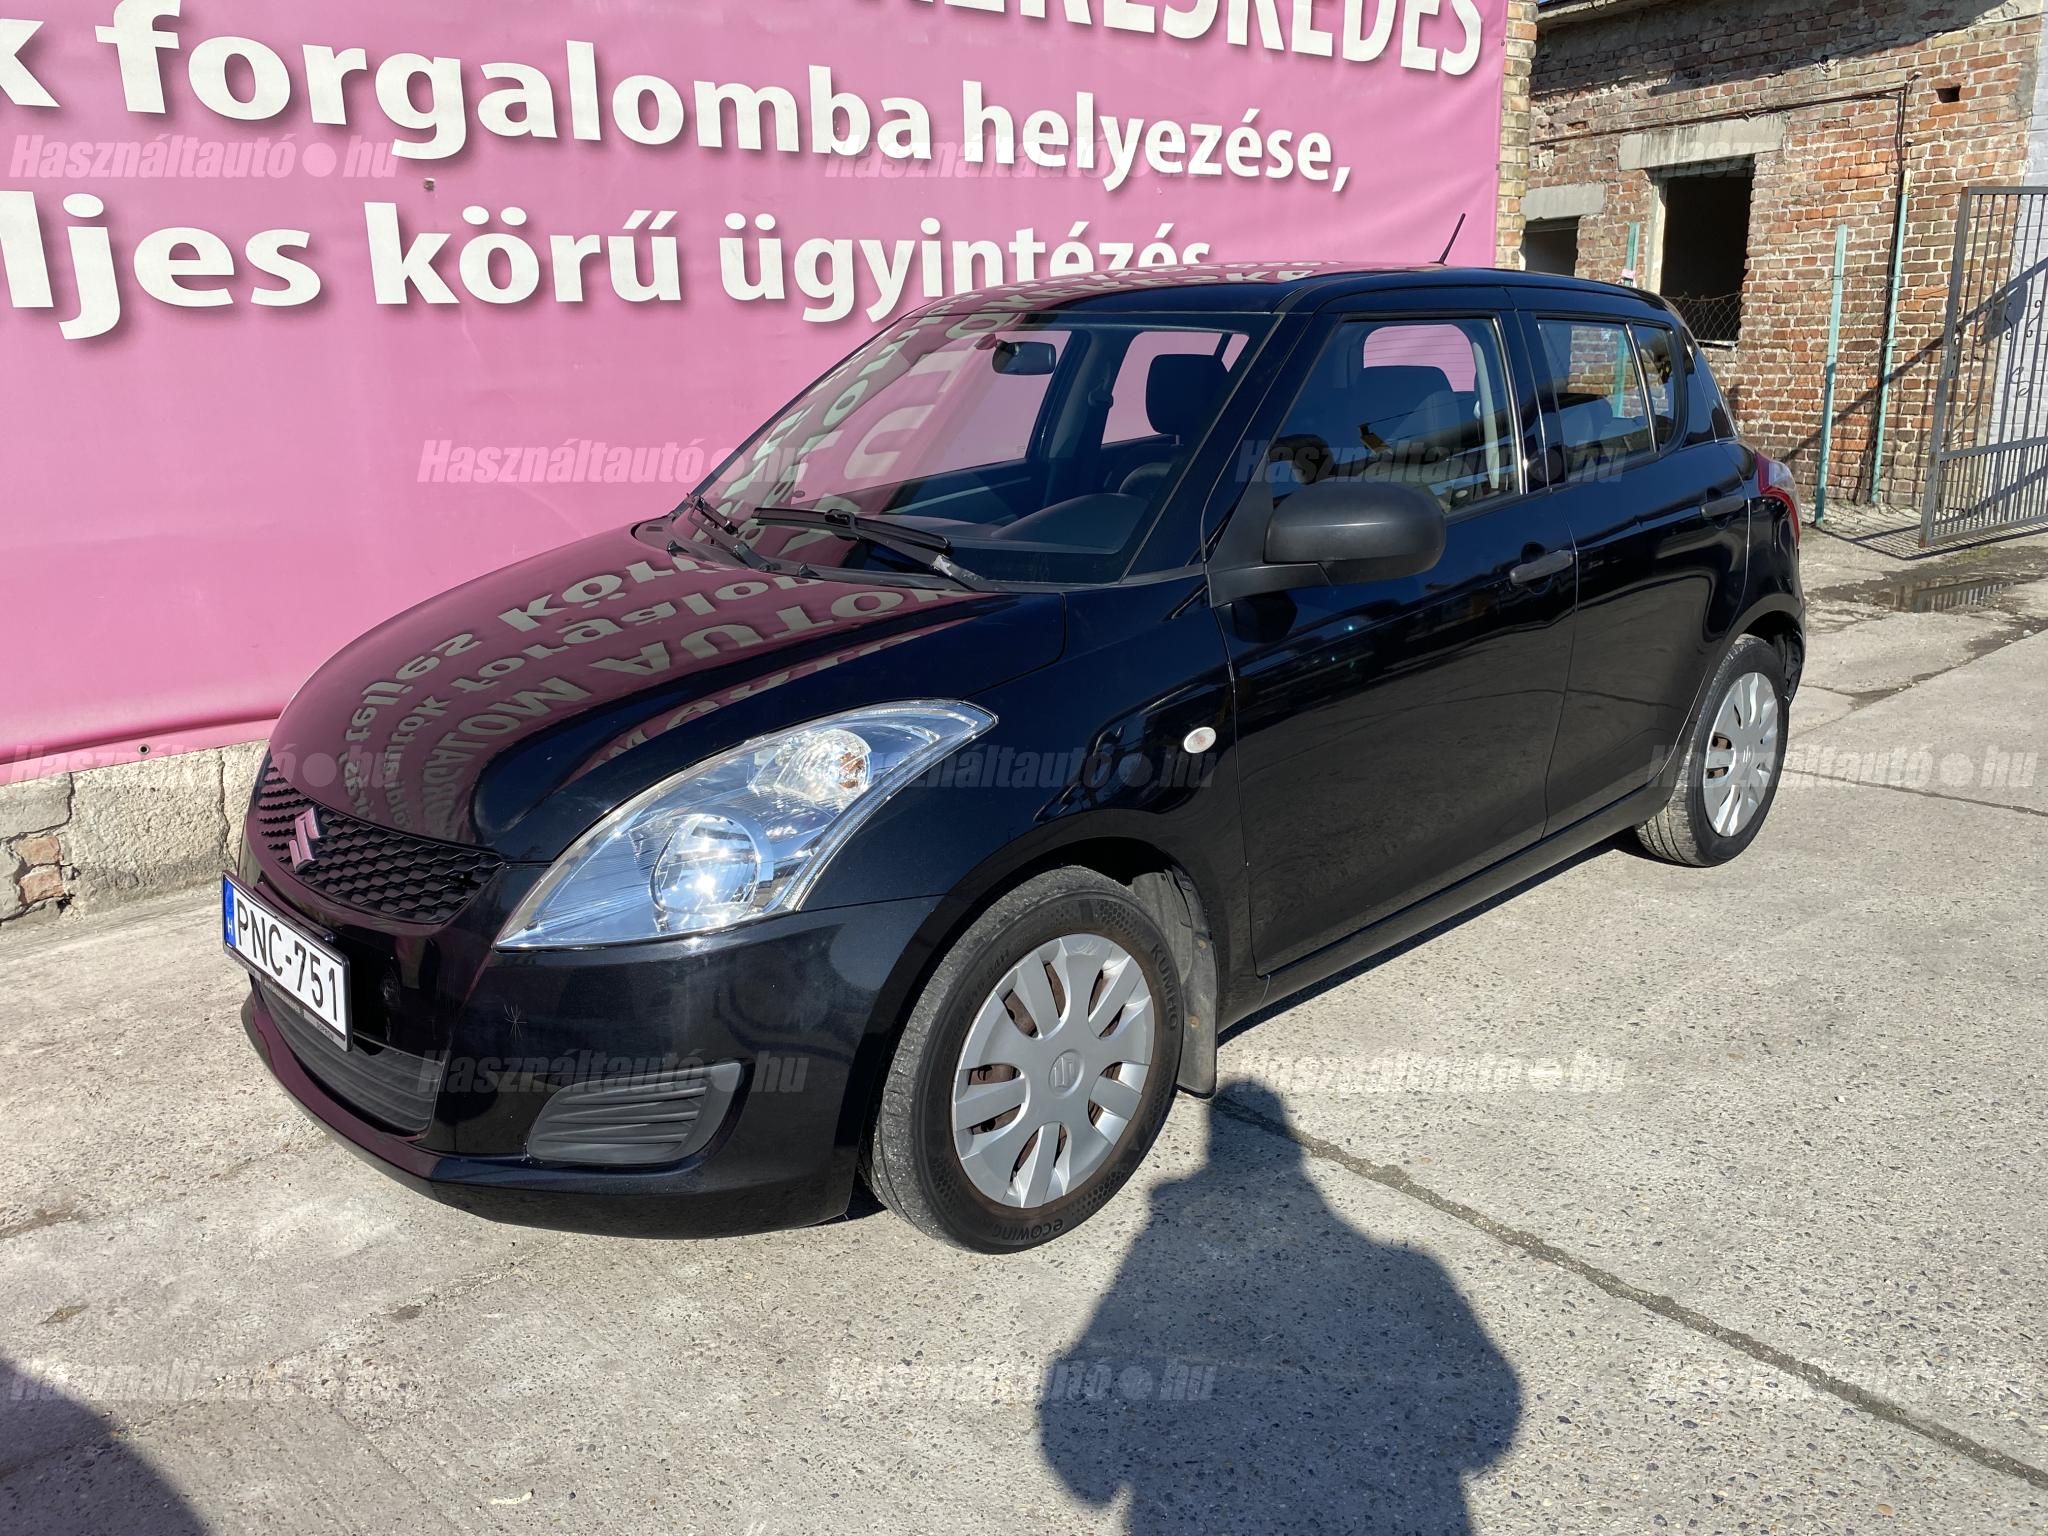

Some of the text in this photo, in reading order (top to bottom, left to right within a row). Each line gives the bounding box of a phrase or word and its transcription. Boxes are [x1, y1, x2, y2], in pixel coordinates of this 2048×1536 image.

[95, 0, 932, 160] forgalomba
[962, 80, 1351, 192] helyezése,
[0, 190, 321, 340] ljes
[364, 201, 681, 304] körű
[237, 898, 338, 1022] PNC-751
[1150, 943, 1178, 1032] KUMHO
